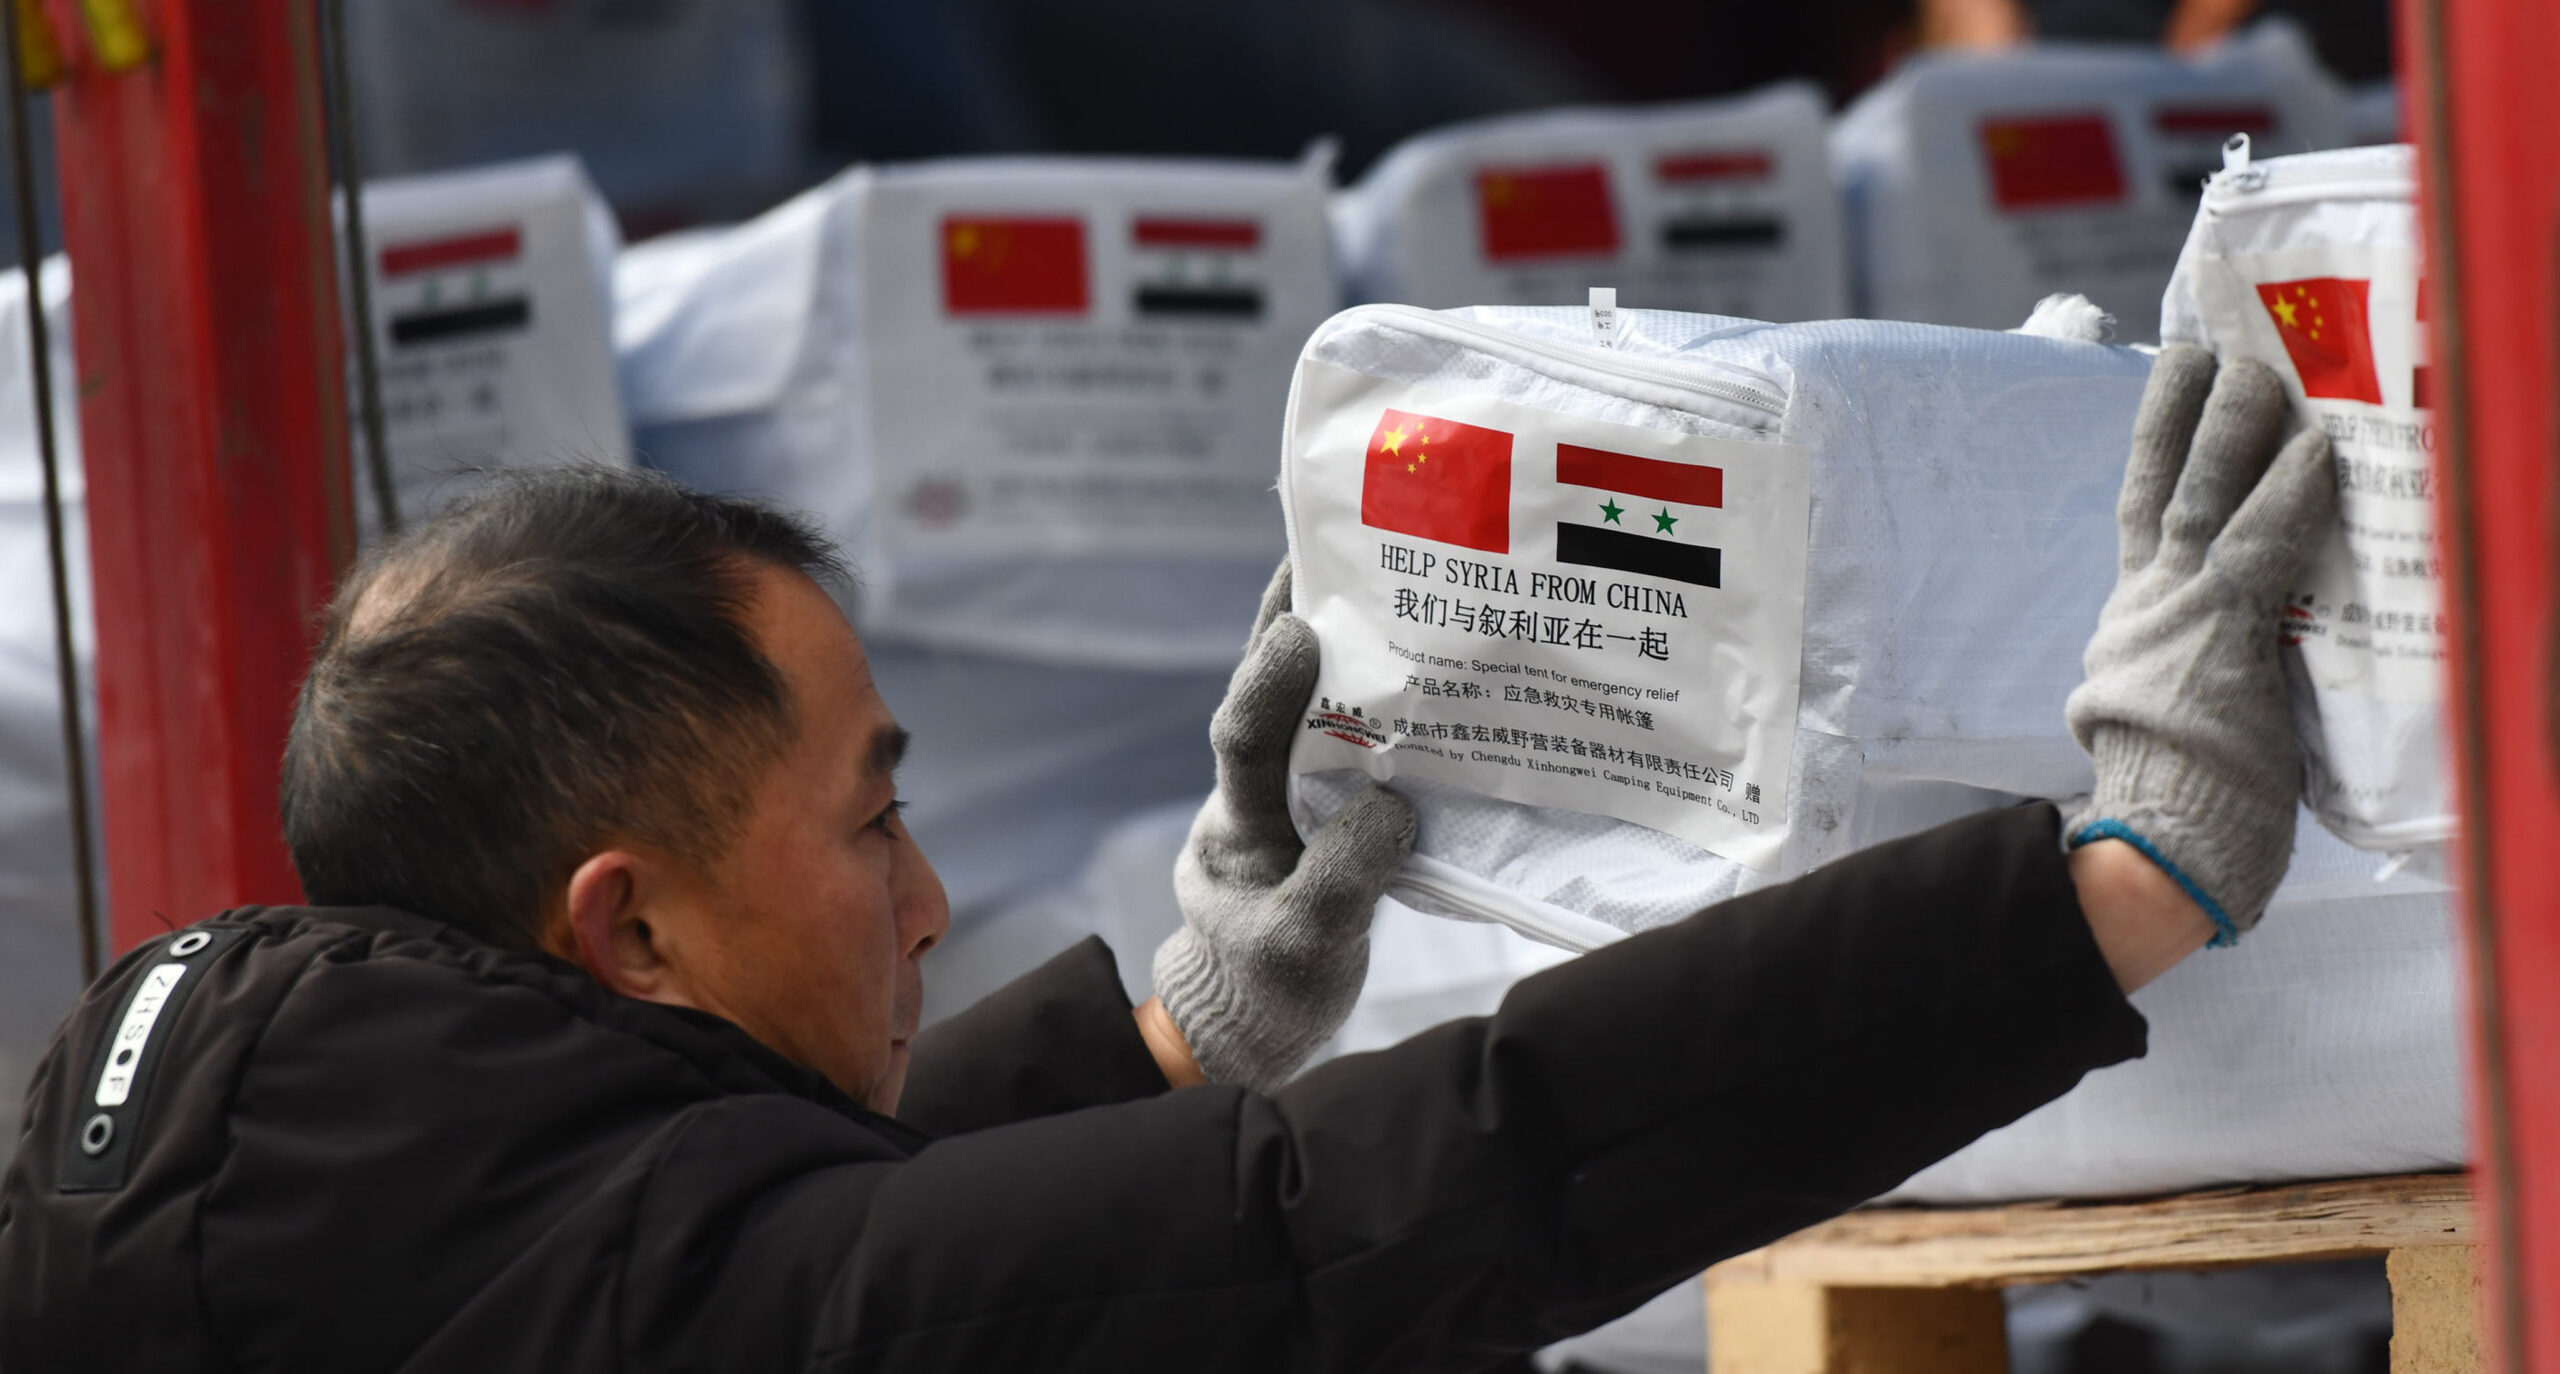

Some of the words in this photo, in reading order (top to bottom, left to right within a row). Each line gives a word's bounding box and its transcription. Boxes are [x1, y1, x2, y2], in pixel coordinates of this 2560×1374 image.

[1380, 543, 1437, 578] HELP
[1445, 558, 1520, 596] SYRIA
[1530, 572, 1597, 606] FROM
[1606, 583, 1688, 618] CHINA
[1393, 587, 1670, 661] 我们与叙利亚在一起
[1388, 640, 1426, 664] Product
[1428, 655, 1468, 670] name:
[1471, 659, 1521, 674] Special
[1524, 665, 1550, 679] tent
[1551, 670, 1568, 684] for
[1570, 676, 1643, 700] emergency
[1645, 687, 1681, 702] relief
[1392, 716, 1735, 793] 成都市鑫宏威野营装备器材有限责任公司
[1449, 749, 1465, 762] by
[1470, 750, 1522, 767] Chengdu
[1526, 757, 1597, 779] Xinhongwei
[1603, 769, 1651, 791] Camping
[1656, 780, 1713, 808] Equipment
[1741, 808, 1760, 826] LTD
